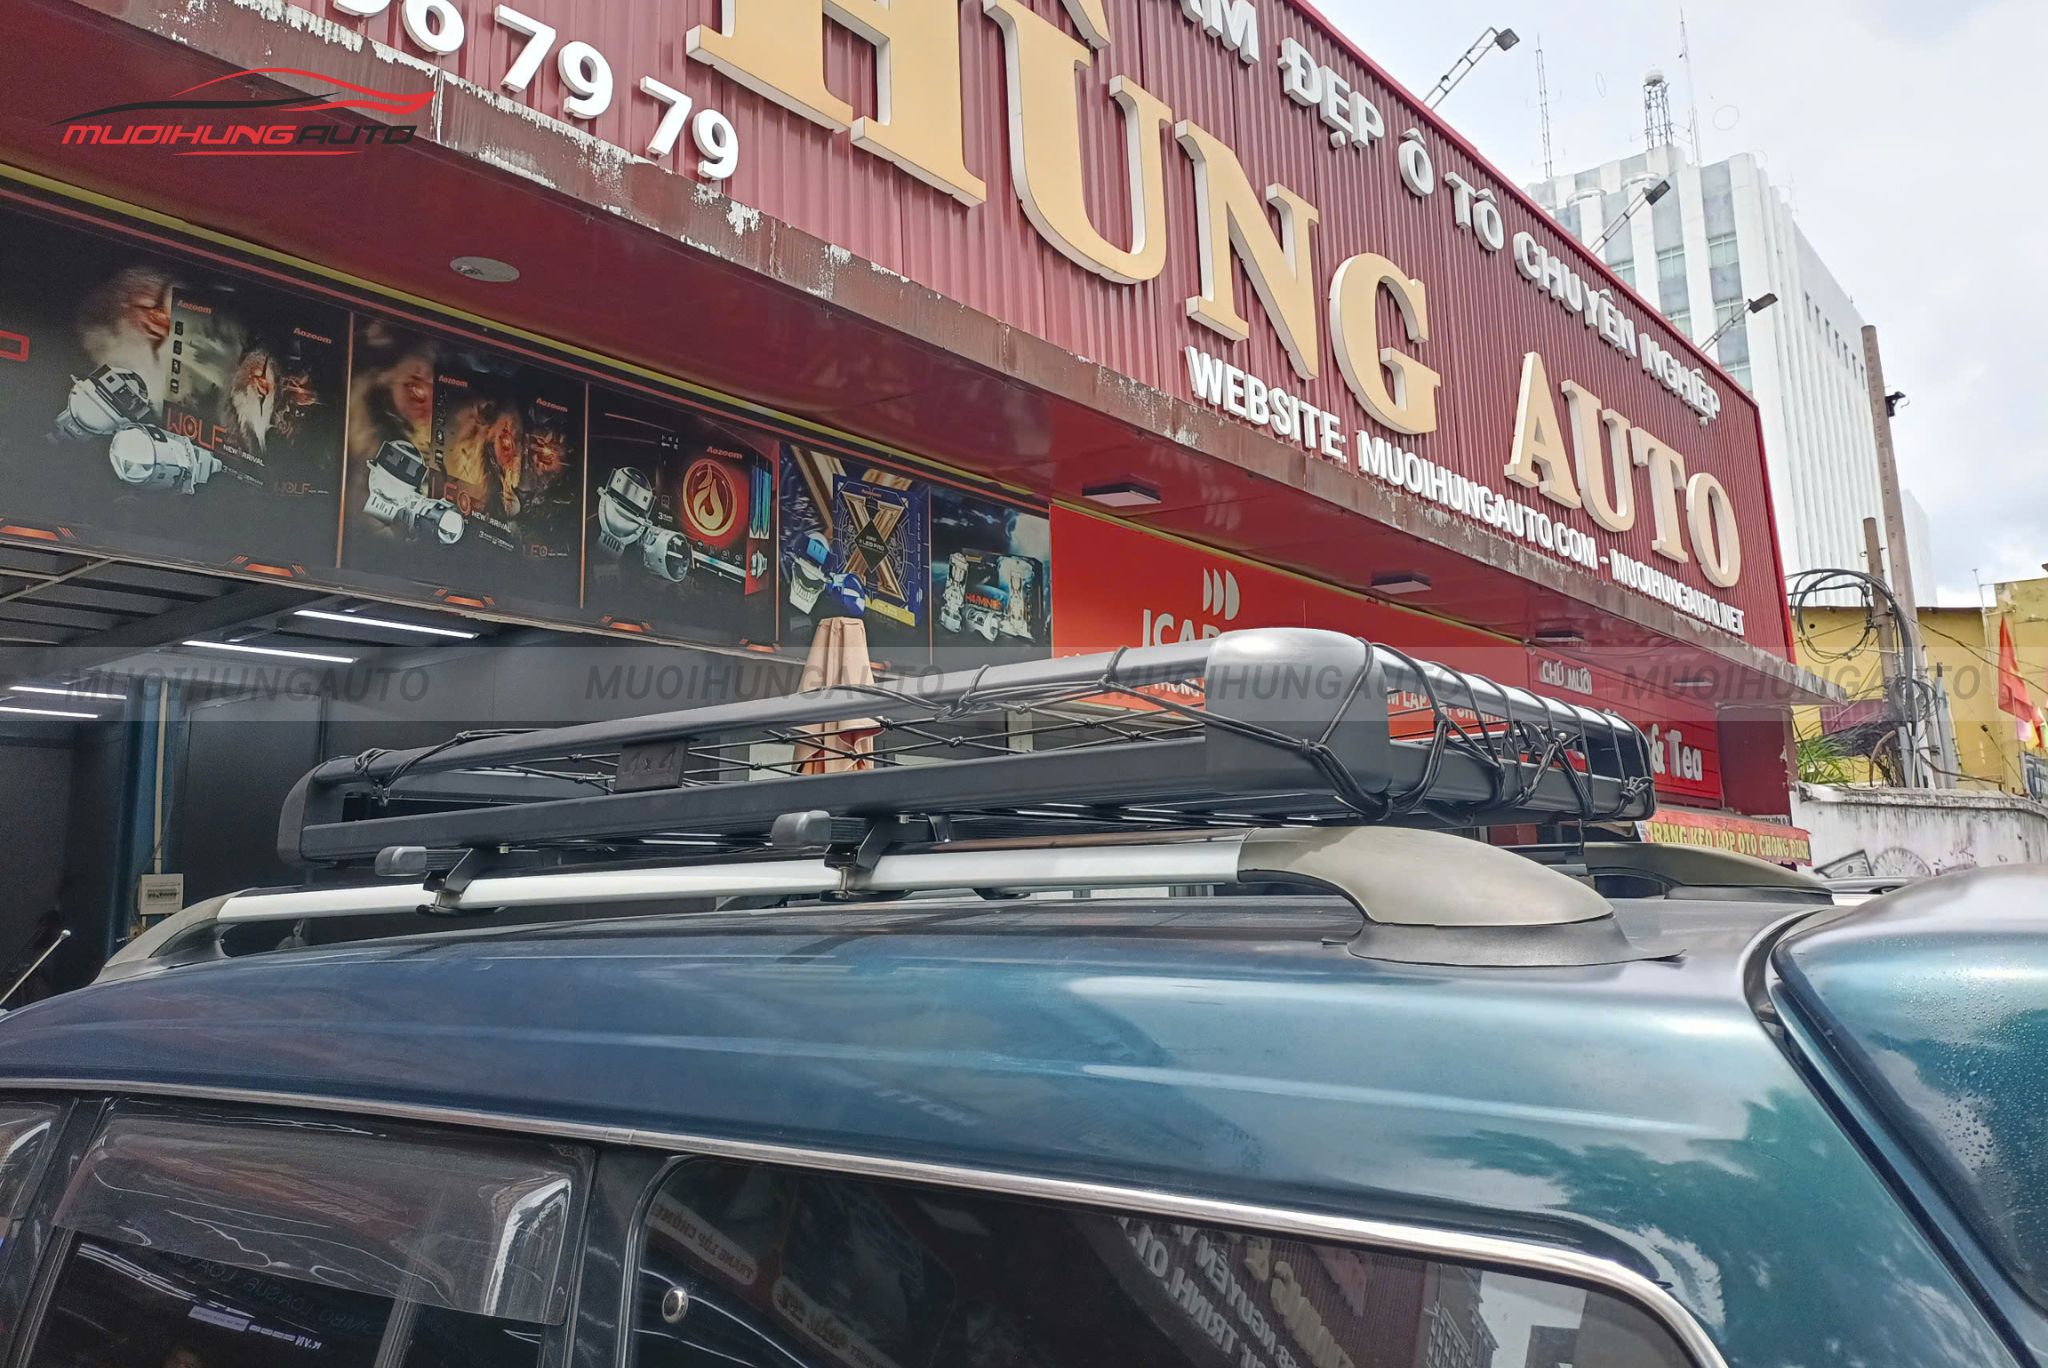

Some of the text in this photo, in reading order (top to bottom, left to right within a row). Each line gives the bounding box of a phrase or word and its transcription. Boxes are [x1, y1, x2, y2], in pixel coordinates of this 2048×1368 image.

[494, 4, 613, 120] 79
[639, 75, 740, 181] 79
[1277, 37, 1385, 149] ĐẸP
[1398, 127, 1434, 198] Ô
[1444, 170, 1505, 253] TÔ
[1513, 231, 1638, 359] CHUYÊN
[1639, 332, 1721, 427] NGHIỆP
[176, 300, 213, 315] Aozoom
[293, 327, 333, 345] Aozoom
[438, 374, 469, 389] Aozoom
[536, 397, 569, 413] Aozoom
[166, 407, 227, 450] WOLF
[706, 446, 743, 460] Aozoom
[1503, 351, 1742, 588] AUTO
[1184, 345, 1348, 464] WEBSITE:
[1356, 430, 1599, 570] MUOIHUNGAUTO.COM
[1609, 549, 1745, 637] MUOIHUNGAUTO.NET
[1540, 660, 1564, 687] CHÚ
[1666, 729, 1703, 781] Tea
[1690, 826, 1713, 848] KEO
